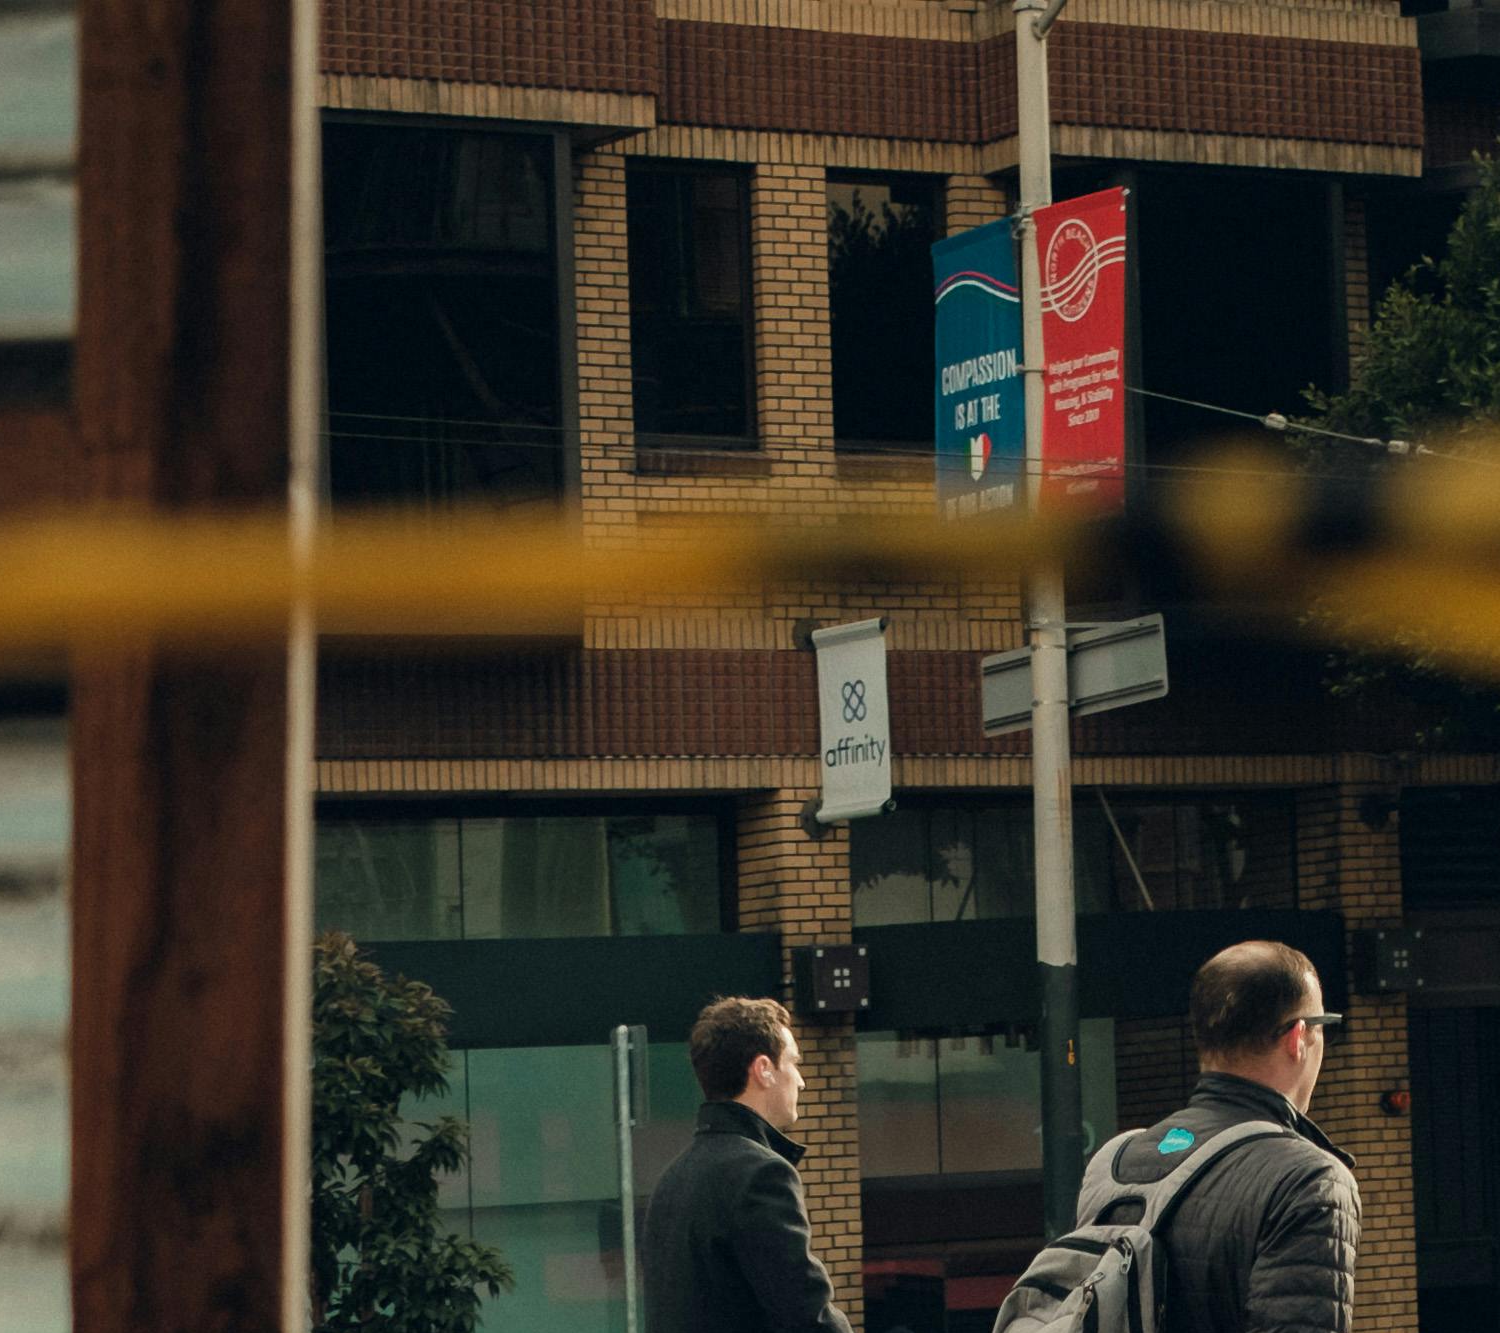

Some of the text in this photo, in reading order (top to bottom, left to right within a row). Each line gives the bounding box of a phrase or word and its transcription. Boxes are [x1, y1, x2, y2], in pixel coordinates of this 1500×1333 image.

[942, 348, 1017, 396] COMPASSION
[955, 393, 1001, 431] IS AT THE
[825, 734, 886, 767] affinity
